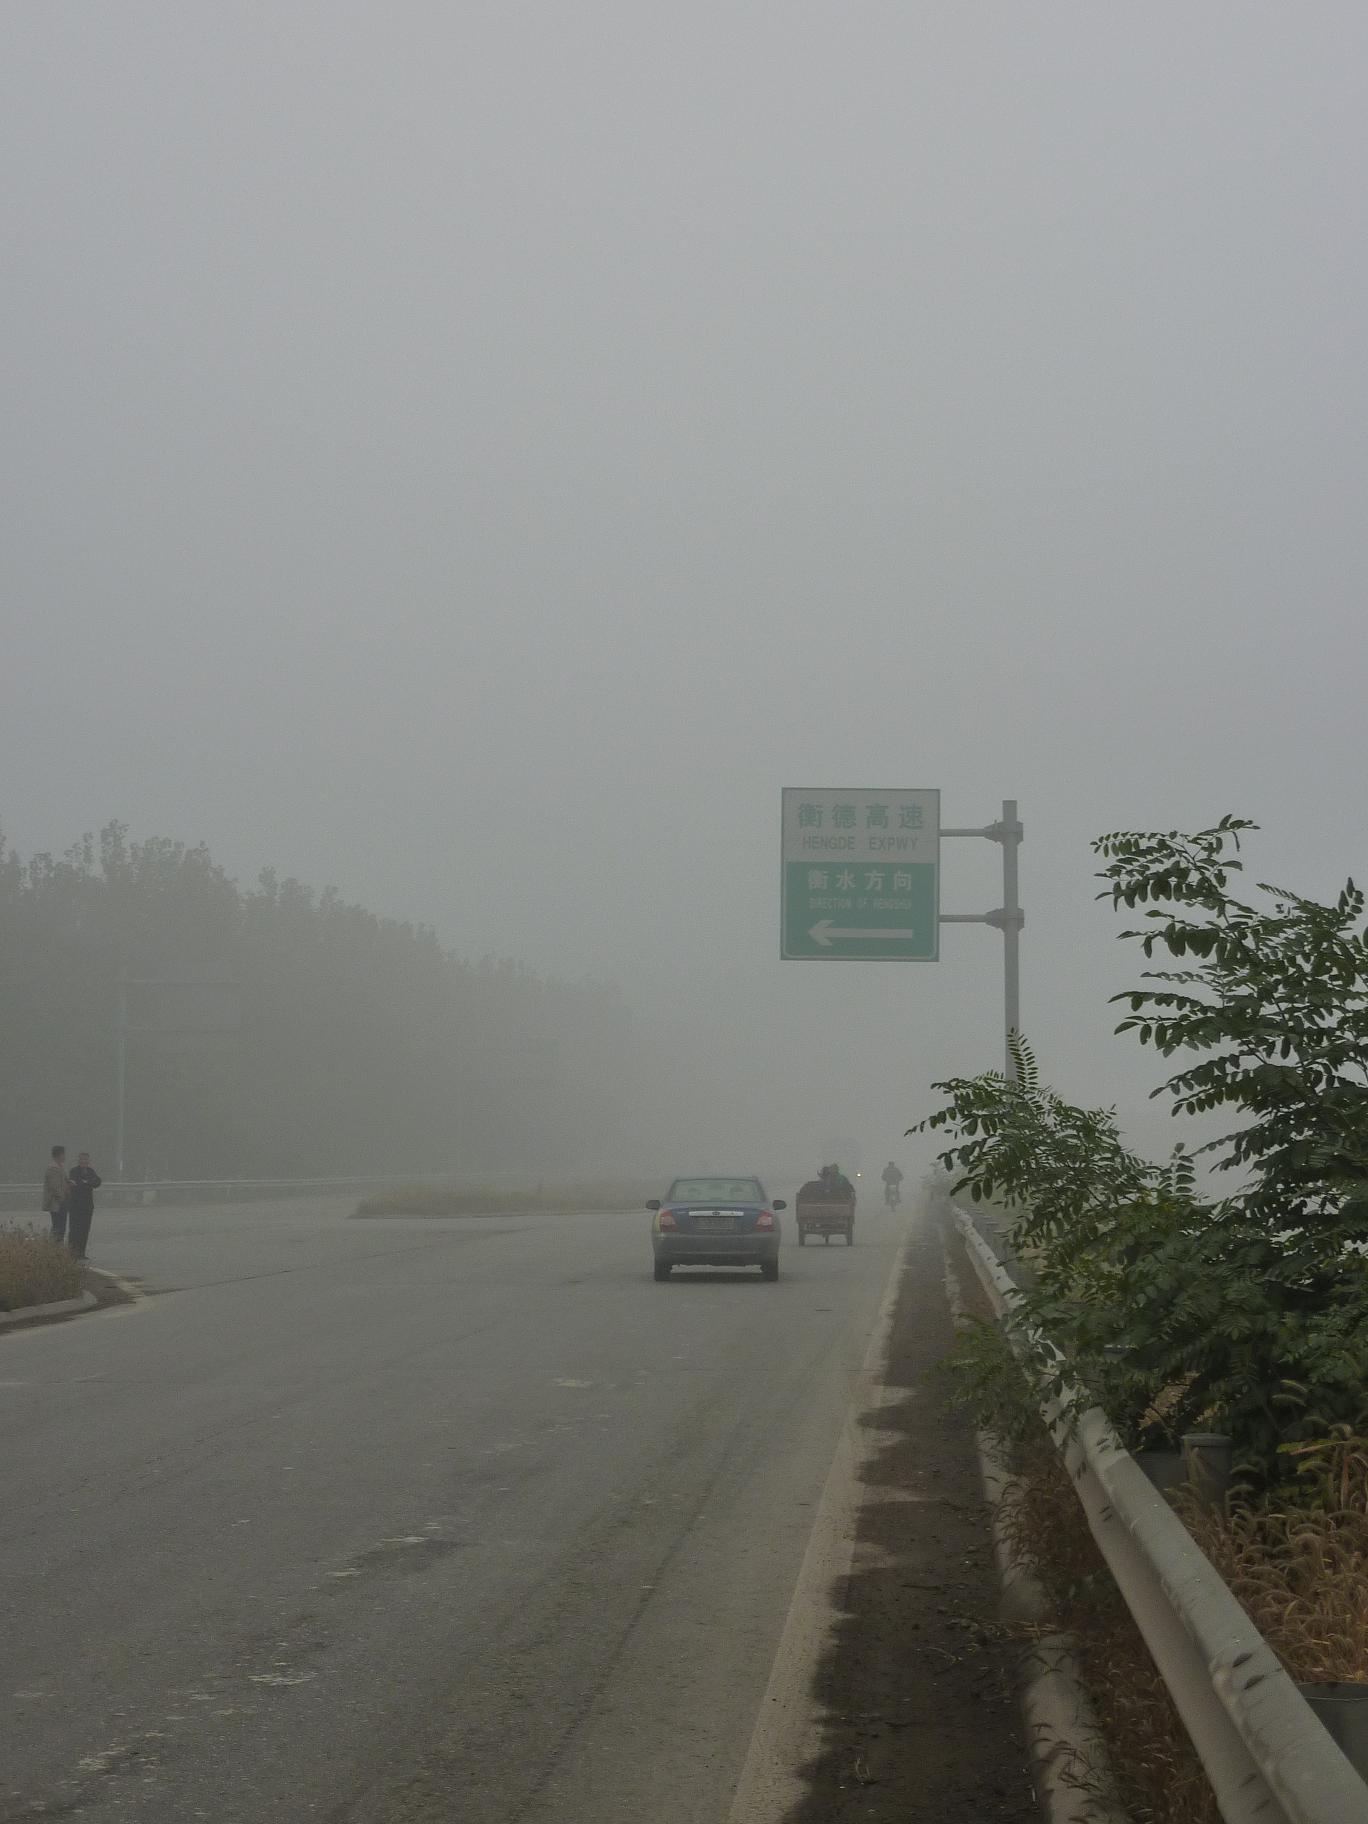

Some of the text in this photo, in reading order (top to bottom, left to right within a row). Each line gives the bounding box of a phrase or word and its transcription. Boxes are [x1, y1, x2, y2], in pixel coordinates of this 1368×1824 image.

[798, 803, 924, 829] 衡德高速
[802, 836, 918, 850] HENGDE EXPWY
[808, 869, 913, 890] 衡水方向
